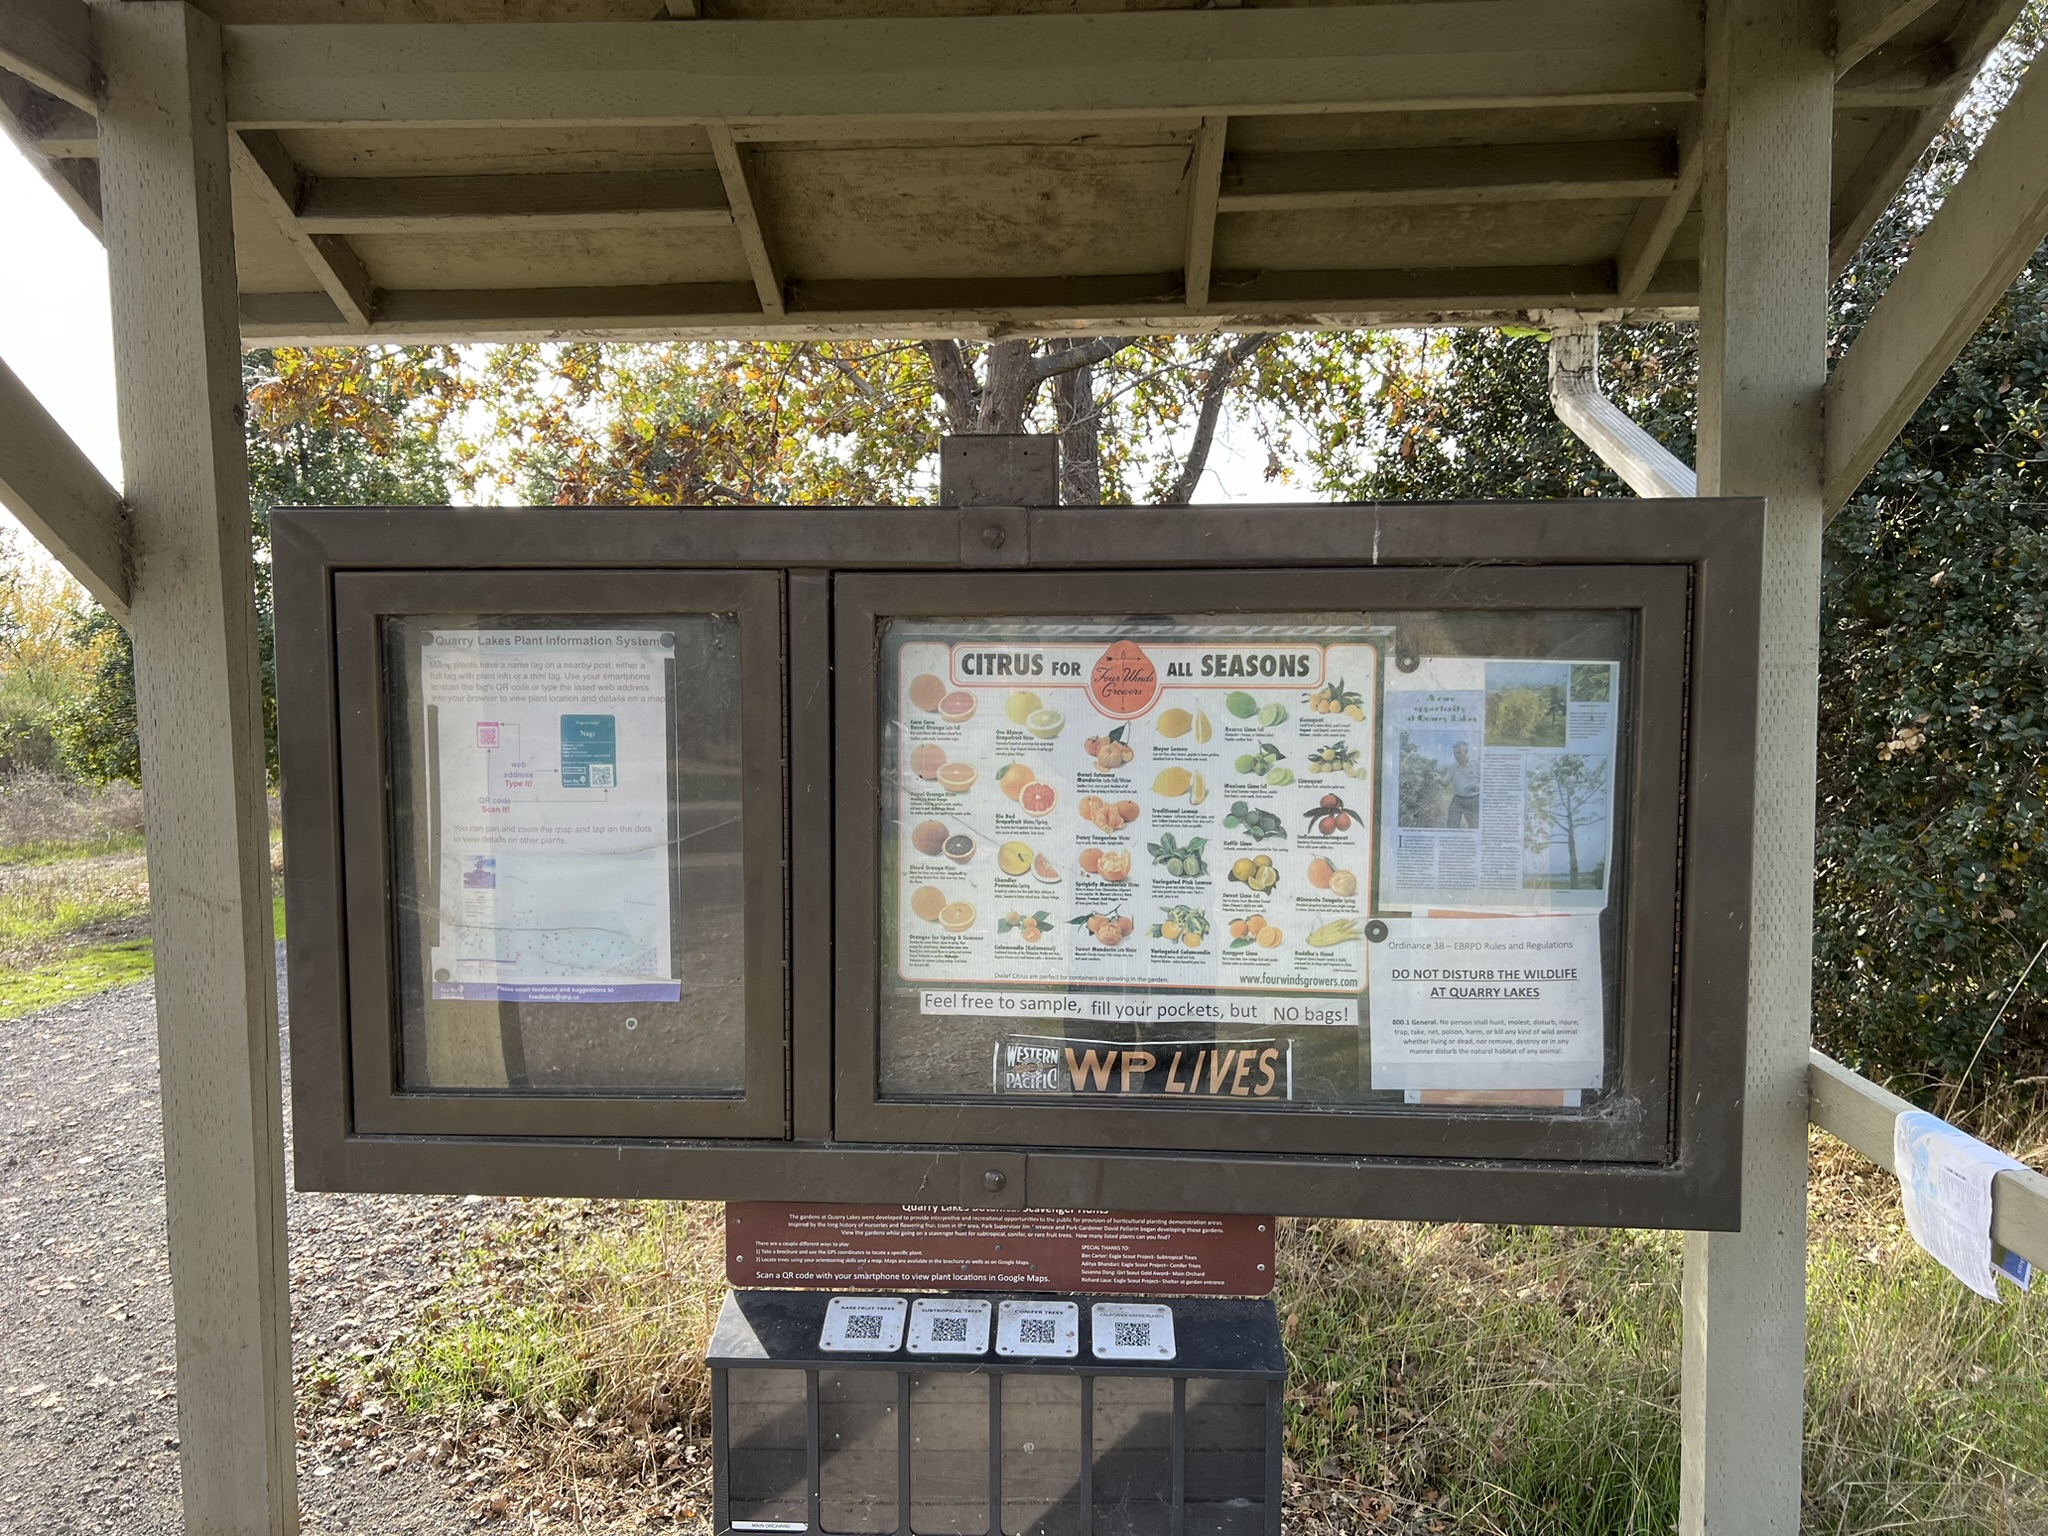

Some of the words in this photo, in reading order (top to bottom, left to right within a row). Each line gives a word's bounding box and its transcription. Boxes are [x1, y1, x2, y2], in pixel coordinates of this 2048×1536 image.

[435, 635, 473, 646] Quarry
[477, 635, 510, 645] Lakes
[514, 635, 542, 645] Plant
[546, 636, 611, 645] Information
[615, 636, 660, 646] System
[961, 652, 1042, 675] CITRUS
[1051, 661, 1080, 676] FOR
[1167, 662, 1192, 676] ALL
[1201, 654, 1309, 677] SEASONS
[1094, 667, 1120, 682] Four
[1123, 668, 1154, 682] Winds
[1102, 682, 1142, 697] Growers
[505, 779, 523, 788] Type
[1388, 941, 1431, 949] Ordinance
[1453, 942, 1482, 950] EBRPD
[1484, 942, 1506, 950] Rules
[1526, 941, 1573, 949] Regulations
[1038, 974, 1058, 982] perfect
[1105, 975, 1129, 984] growing
[1239, 973, 1357, 988] www.fourwindsgrowers.com
[1392, 969, 1409, 978] DO
[1413, 969, 1438, 978] NOT
[1442, 969, 1494, 979] DISTURB
[1498, 969, 1519, 979] THE
[1523, 968, 1576, 978] WILDLIFE
[1430, 987, 1446, 996] AT
[1449, 987, 1500, 997] QUARRY
[1504, 987, 1539, 997] LAKES
[925, 993, 956, 1008] Feel
[962, 994, 993, 1009] free
[999, 996, 1014, 1009] to
[1020, 998, 1083, 1012] sample,
[1092, 1000, 1110, 1015] fill
[1115, 1005, 1152, 1018] your
[1157, 1005, 1226, 1018] pockets,
[1230, 1004, 1257, 1017] but
[1274, 1006, 1298, 1020] NO
[1305, 1008, 1347, 1024] bags!
[1007, 1046, 1058, 1064] WESTERN
[1006, 1068, 1057, 1089] PACIFIC
[1065, 1048, 1156, 1092] WP
[1164, 1048, 1279, 1096] LIVES
[781, 1271, 793, 1279] QR
[997, 1273, 1024, 1282] Google
